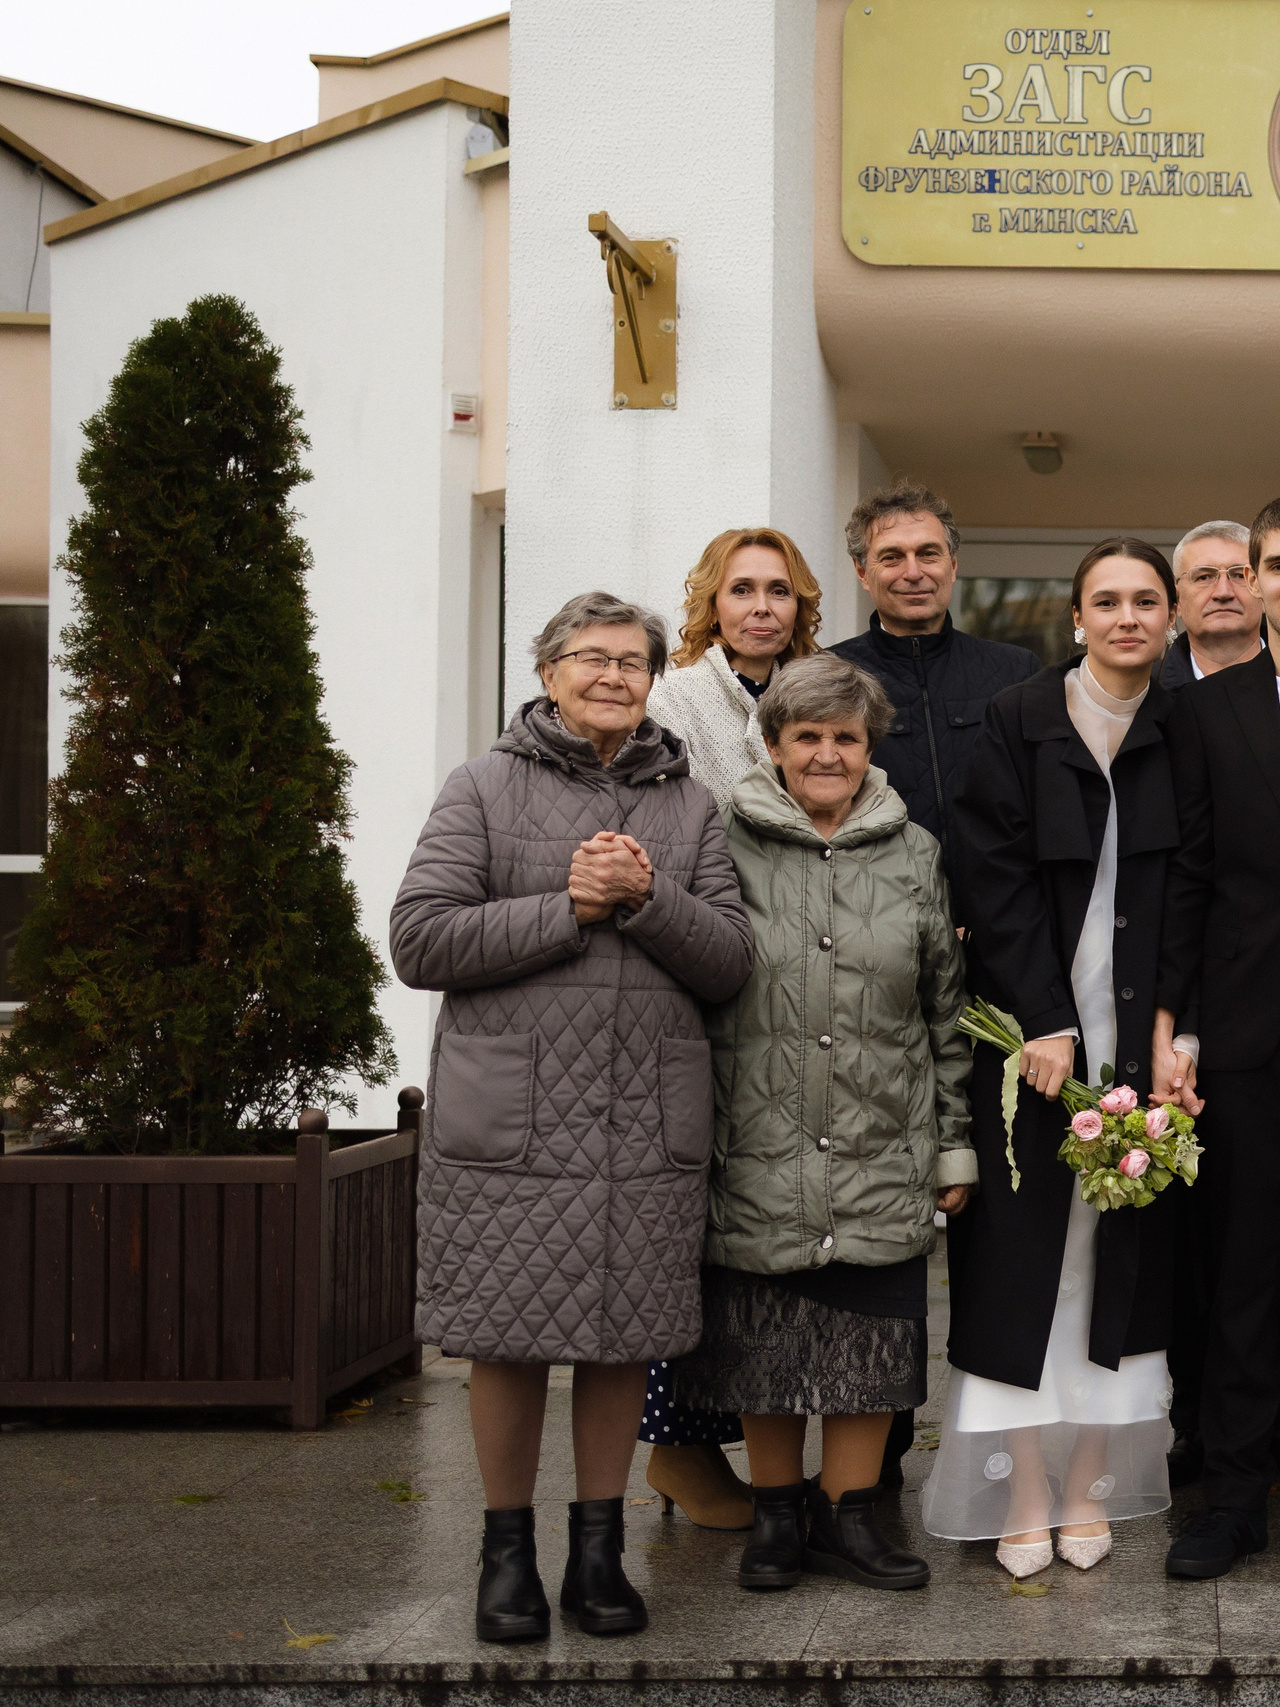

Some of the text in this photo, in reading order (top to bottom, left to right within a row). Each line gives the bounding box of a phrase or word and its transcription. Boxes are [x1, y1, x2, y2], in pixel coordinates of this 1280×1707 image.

[1004, 28, 1110, 59] ОТДЕЛ
[962, 63, 1152, 124] ЗАГС
[908, 128, 1204, 161] АДМИНИСТРАЦИИ
[858, 164, 1252, 197] ФРУНЗЕНСКОГО РАЙОНА
[972, 208, 1138, 234] г. МИНСКА
